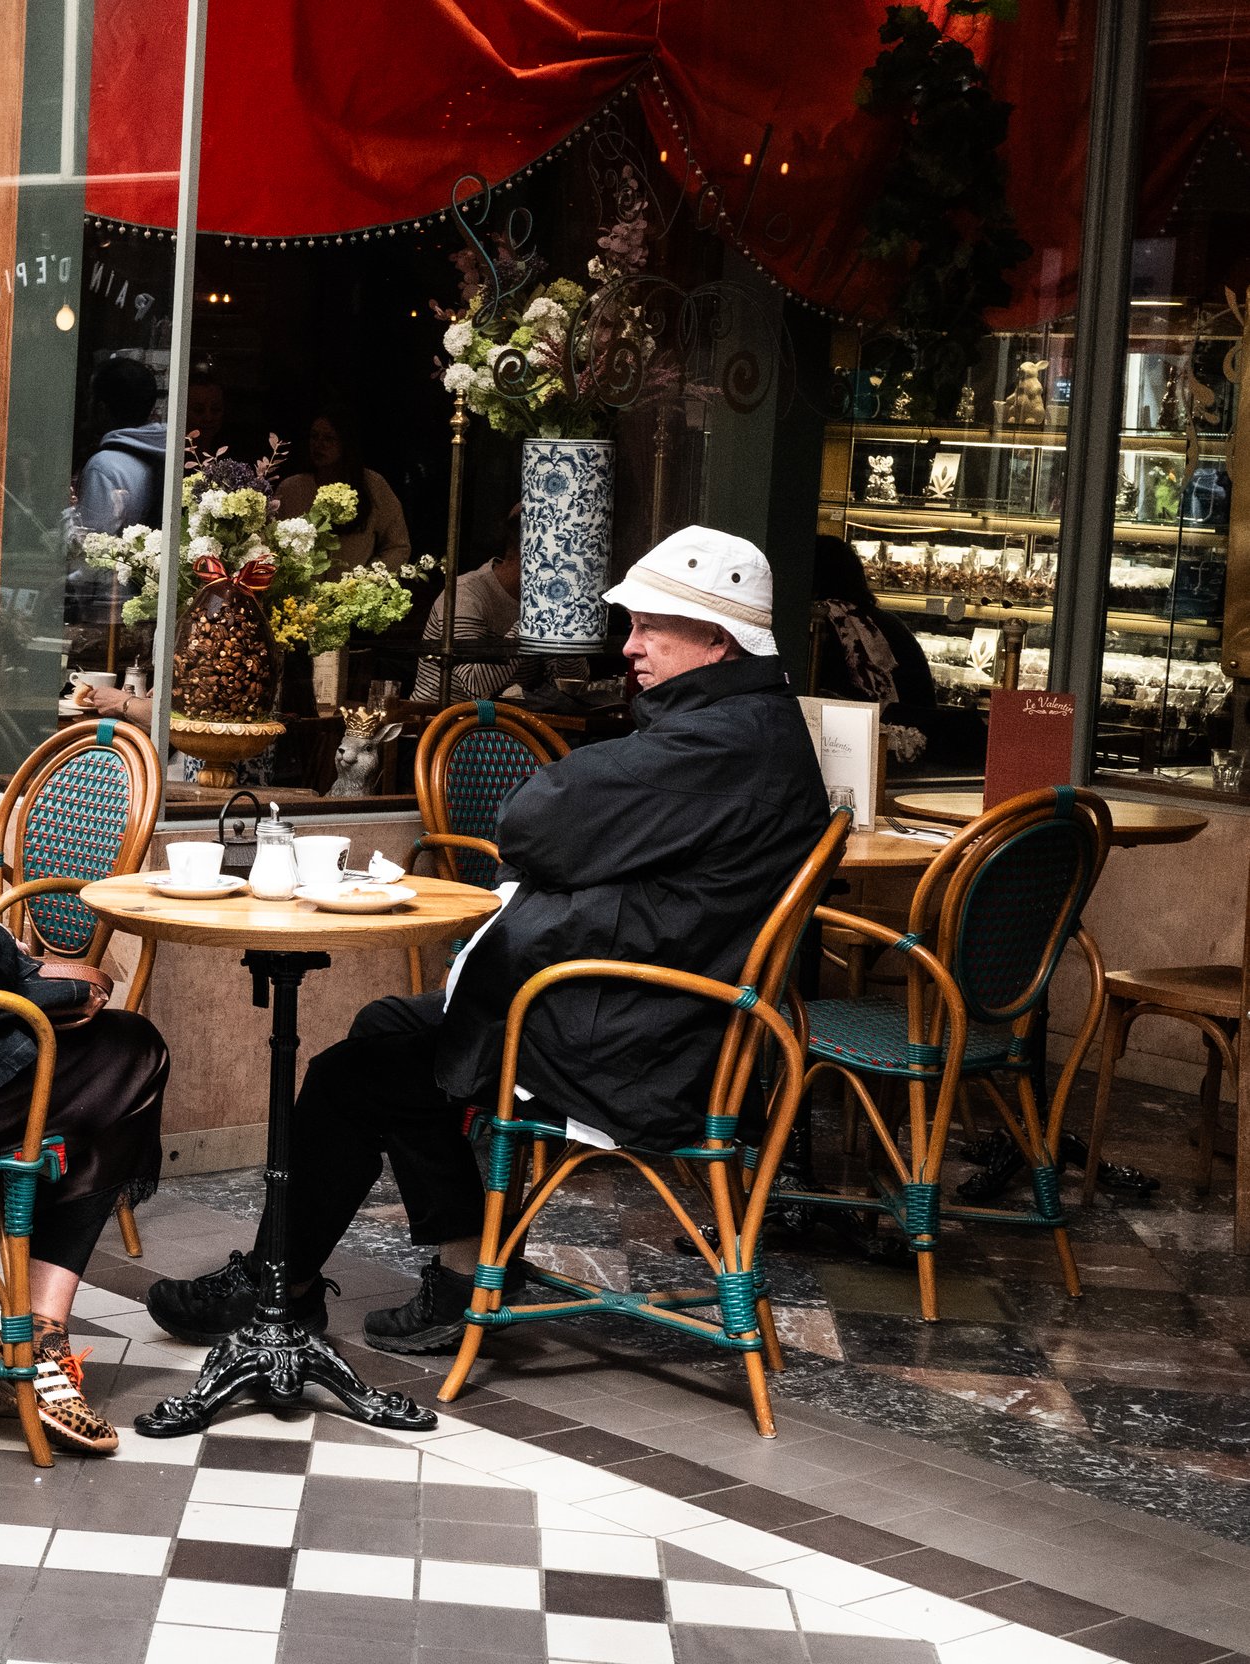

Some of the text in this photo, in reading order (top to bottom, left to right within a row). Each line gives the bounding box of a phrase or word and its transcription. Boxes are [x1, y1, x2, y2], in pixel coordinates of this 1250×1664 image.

[1023, 696, 1074, 714] Le Valentin
[823, 736, 853, 753] Valentin
